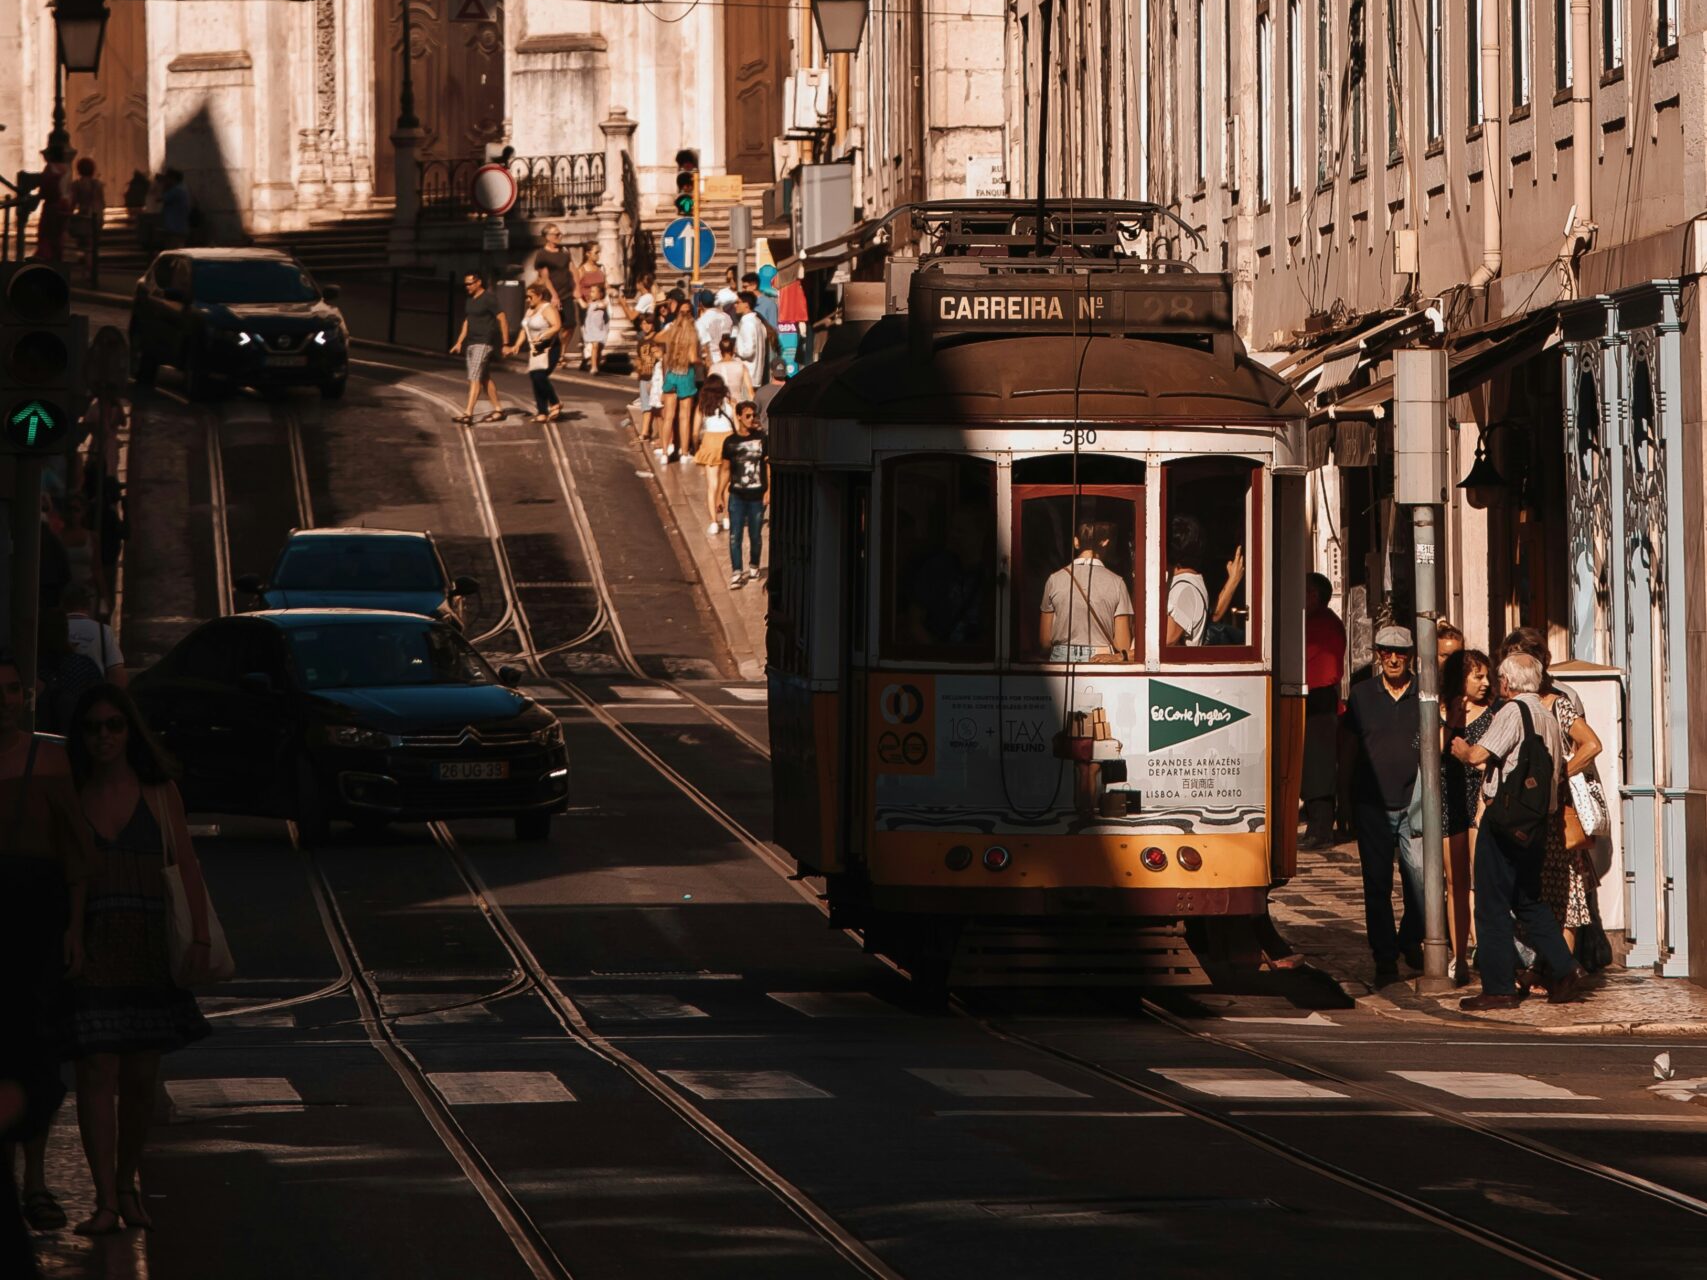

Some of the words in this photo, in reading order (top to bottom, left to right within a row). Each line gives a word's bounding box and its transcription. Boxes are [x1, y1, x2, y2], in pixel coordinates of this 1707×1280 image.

[940, 296, 1064, 320] CARREIRA
[1143, 295, 1195, 321] 28
[1150, 705, 1165, 721] El
[1164, 706, 1194, 721] Corte
[1193, 702, 1232, 727] Inglés
[1005, 719, 1045, 743] TAX
[1003, 742, 1047, 754] REFUND
[1147, 758, 1193, 767] GRANDES
[1196, 757, 1241, 767] ARMAZÉNS
[1148, 768, 1208, 776] DEPARTMENT
[1211, 767, 1241, 776] STORES
[1146, 790, 1180, 798] LISBOA
[1190, 789, 1214, 798] GAIA
[1216, 789, 1243, 797] PORTO
